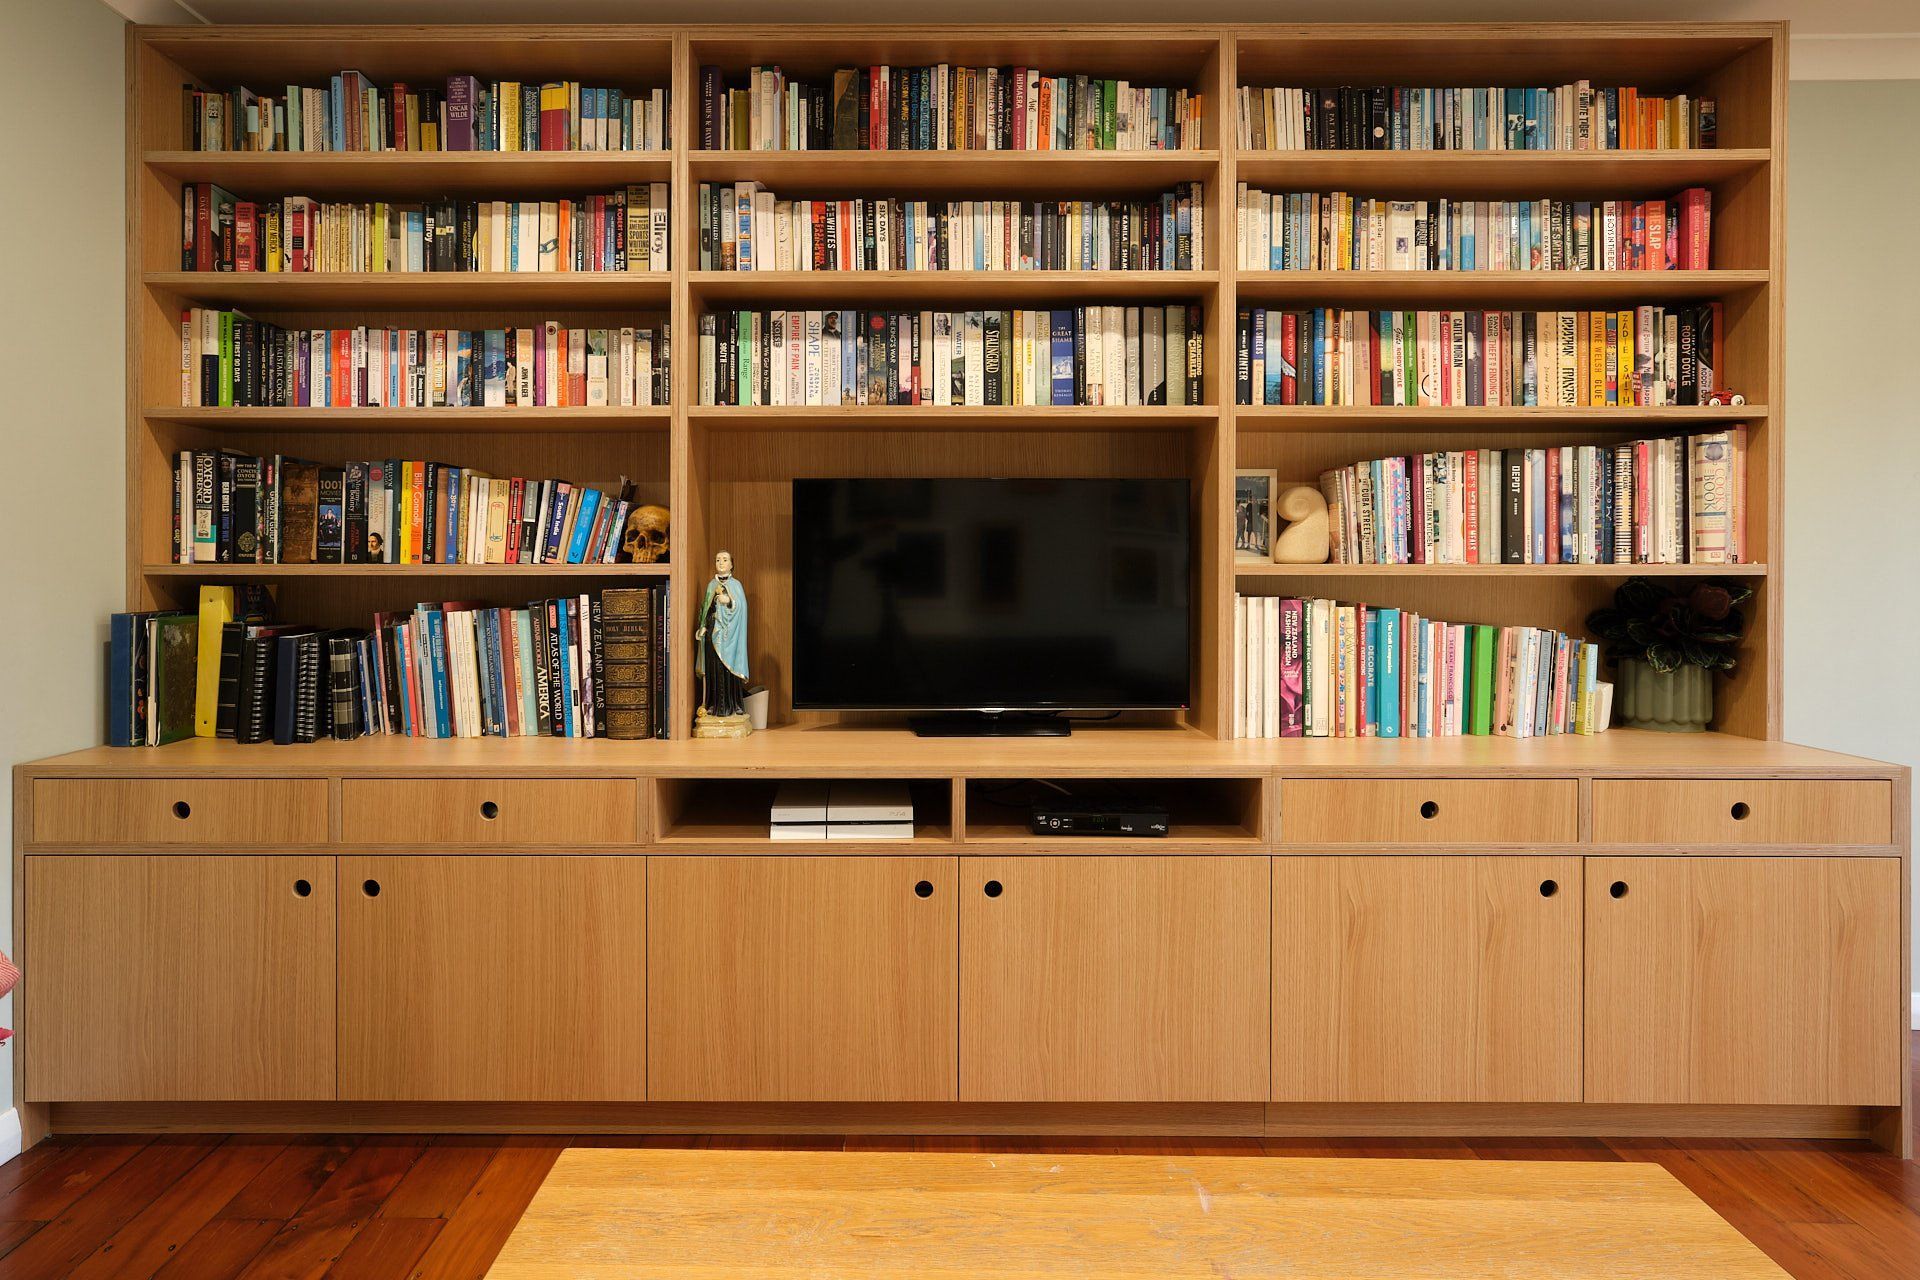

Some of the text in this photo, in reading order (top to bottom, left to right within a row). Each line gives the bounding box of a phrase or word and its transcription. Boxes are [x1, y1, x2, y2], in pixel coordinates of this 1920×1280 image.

[1579, 96, 1589, 138] WHITE TIGER
[200, 196, 208, 220] OATES
[270, 232, 278, 253] MERCKX
[425, 218, 434, 242] Ellroy
[629, 231, 648, 239] SPORTS
[629, 240, 648, 248] WRITING
[652, 215, 666, 253] Ellroy
[827, 218, 835, 248] WHITES
[1552, 206, 1562, 262] ZADIE SMITH
[1650, 206, 1661, 249] THE SLAP
[791, 315, 800, 370] EMPIRE OF PAIN
[808, 321, 820, 357] SHAPE
[986, 330, 1000, 373] STALINGRAD
[1453, 319, 1462, 368] CAITLIN MORAN
[1562, 316, 1574, 356] JONATHAN
[741, 358, 749, 379] Range
[1188, 339, 1197, 378] CHARLIE
[1239, 349, 1249, 380] WINTER
[1489, 339, 1498, 395] THEFT FINDING
[1682, 325, 1691, 386] RODDY DOYLE
[203, 458, 212, 504] OXFORD
[320, 481, 341, 489] 1001
[1467, 455, 1476, 488] JAMIE'S
[1511, 466, 1520, 494] DEPOT
[412, 473, 423, 527] Billy Connolly
[1704, 474, 1715, 510] BOOK
[1715, 468, 1725, 512] COOK'S
[555, 502, 564, 520] South
[1362, 510, 1371, 536] STREET
[1468, 505, 1476, 528] MINUTE
[550, 633, 559, 657] ATLAS
[552, 658, 558, 669] OF
[536, 666, 549, 720] AMERICA
[553, 690, 562, 720] WORLD
